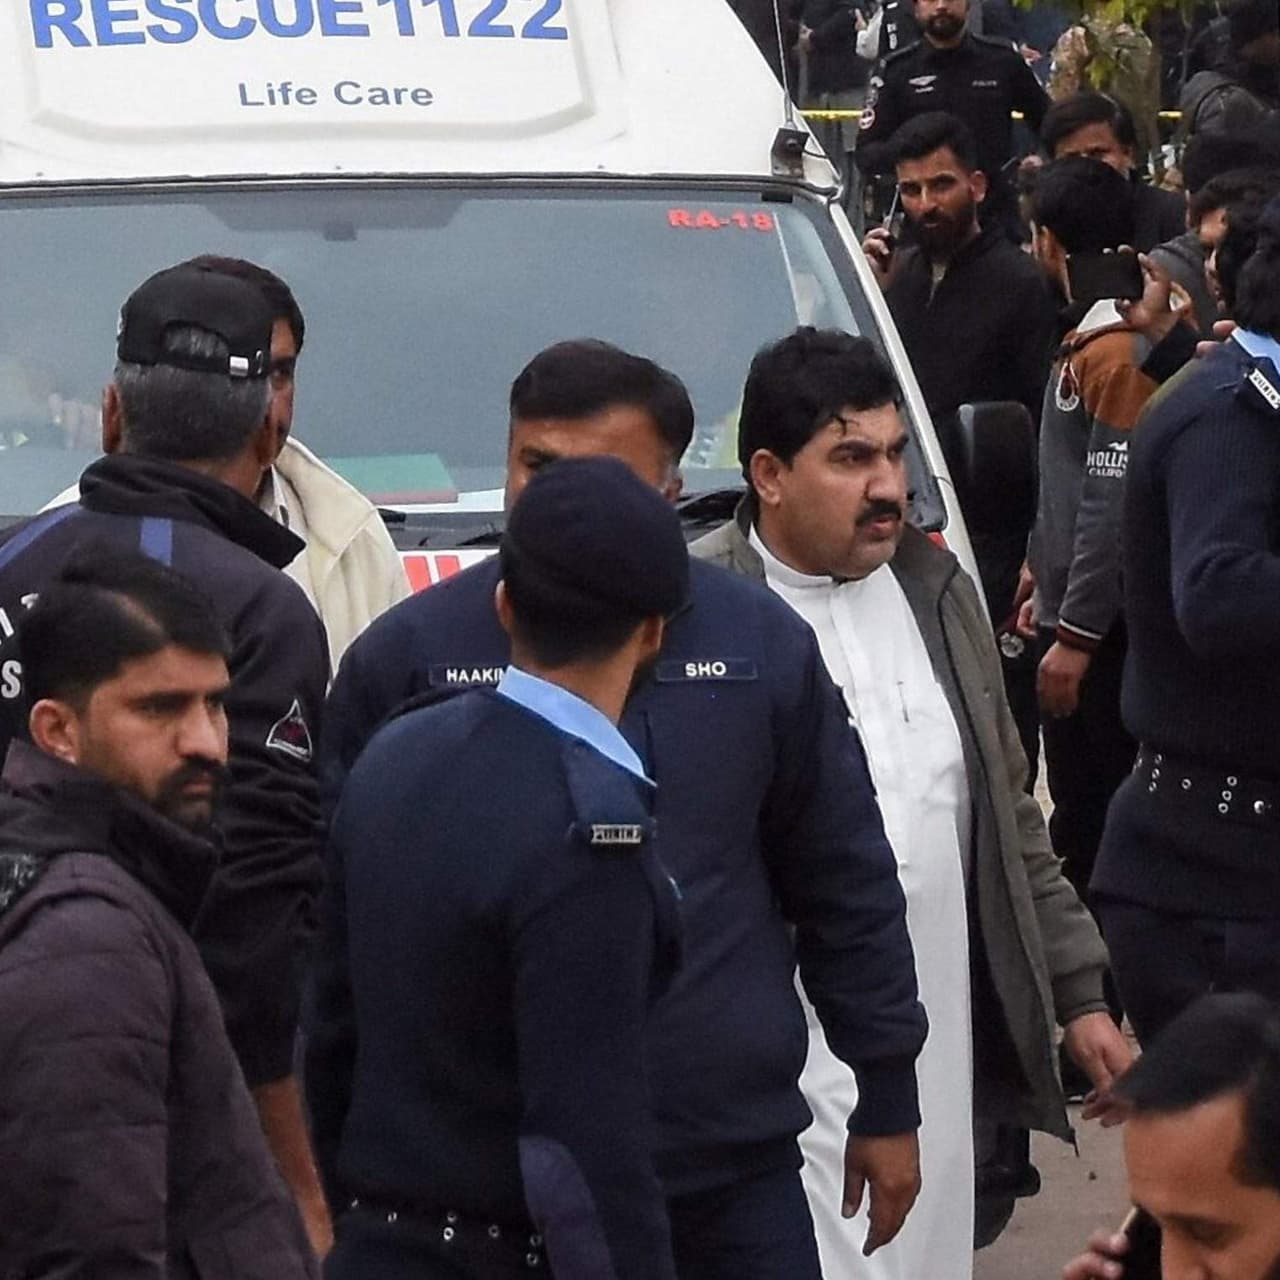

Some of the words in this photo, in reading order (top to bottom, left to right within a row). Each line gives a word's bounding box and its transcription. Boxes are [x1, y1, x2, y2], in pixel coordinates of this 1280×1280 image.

[238, 80, 318, 107] Life
[333, 80, 434, 107] Care
[666, 207, 775, 232] RA-18
[1088, 467, 1127, 478] CALIFO
[1, 659, 22, 698] S
[685, 661, 727, 677] SHO
